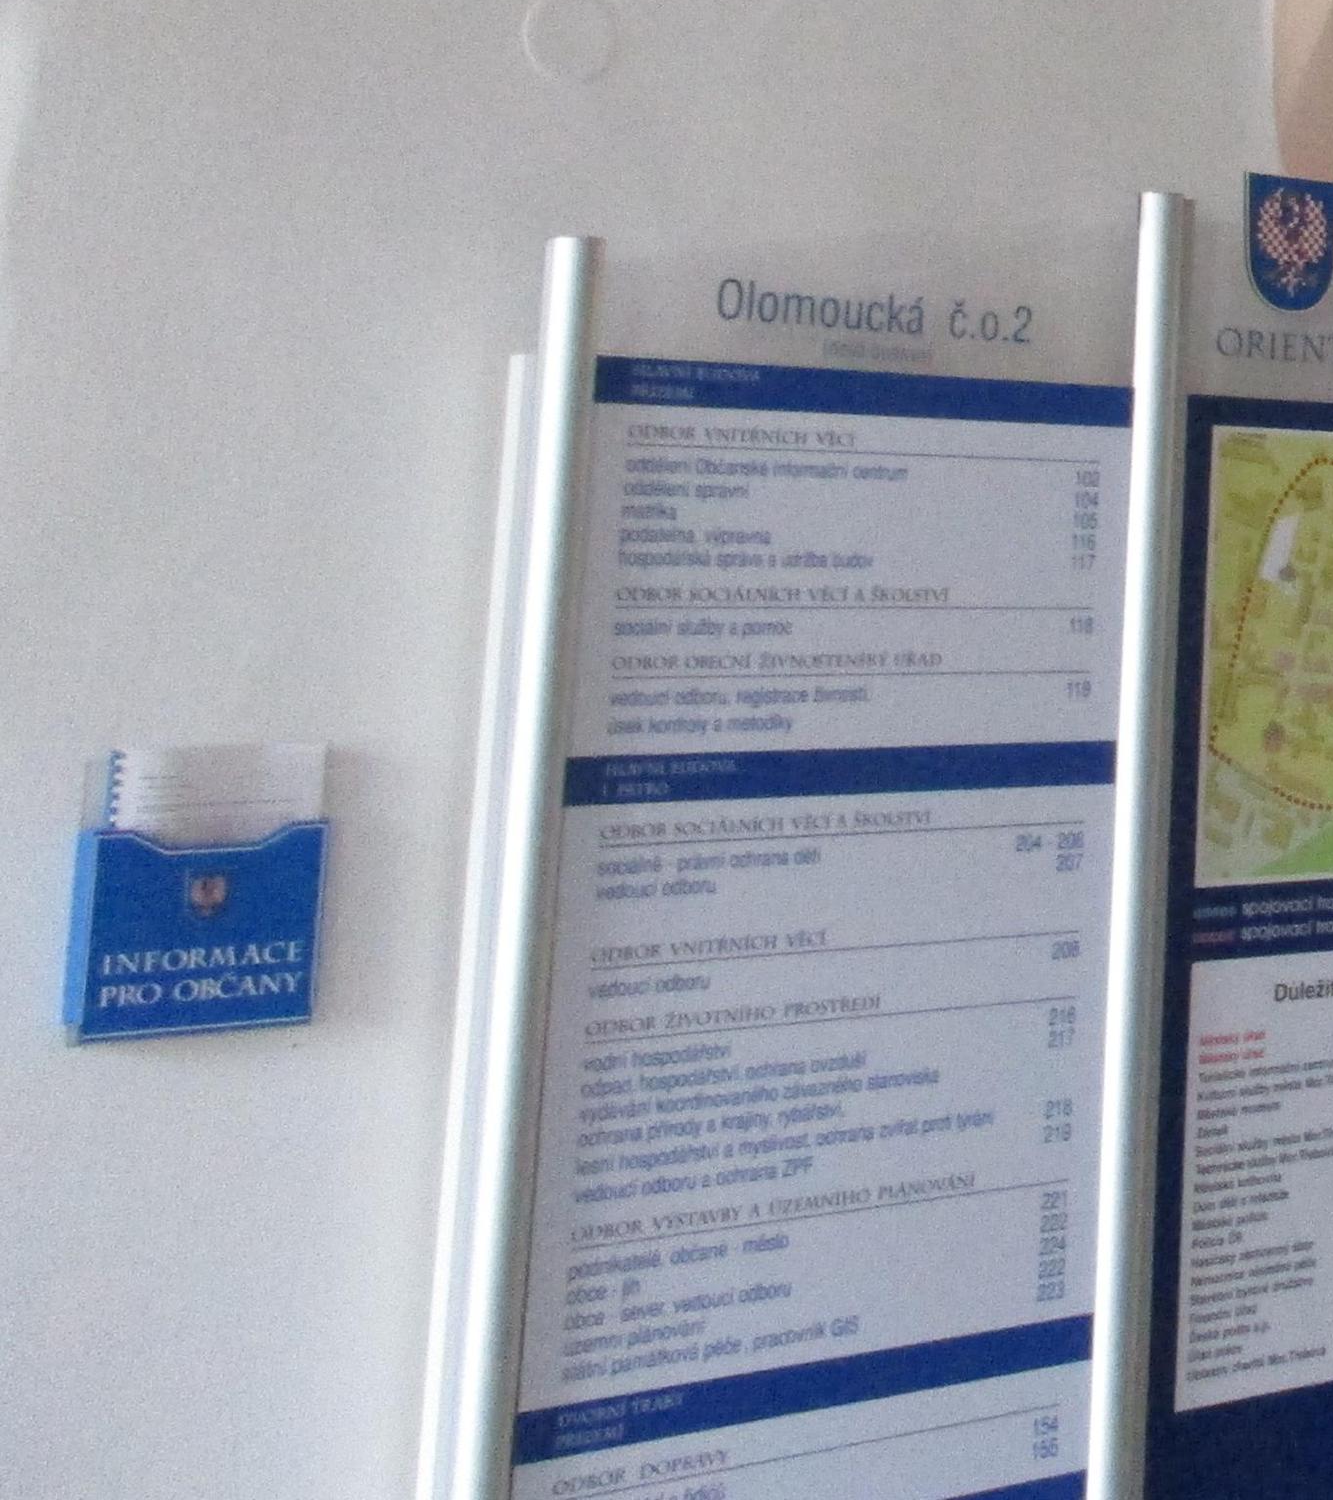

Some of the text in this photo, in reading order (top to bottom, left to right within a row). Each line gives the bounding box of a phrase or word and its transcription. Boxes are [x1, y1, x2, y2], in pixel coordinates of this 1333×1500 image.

[717, 278, 1033, 344] Olomoucká č.o.2
[101, 940, 305, 976] INFORMACE
[99, 970, 304, 1008] PRO OBČANY
